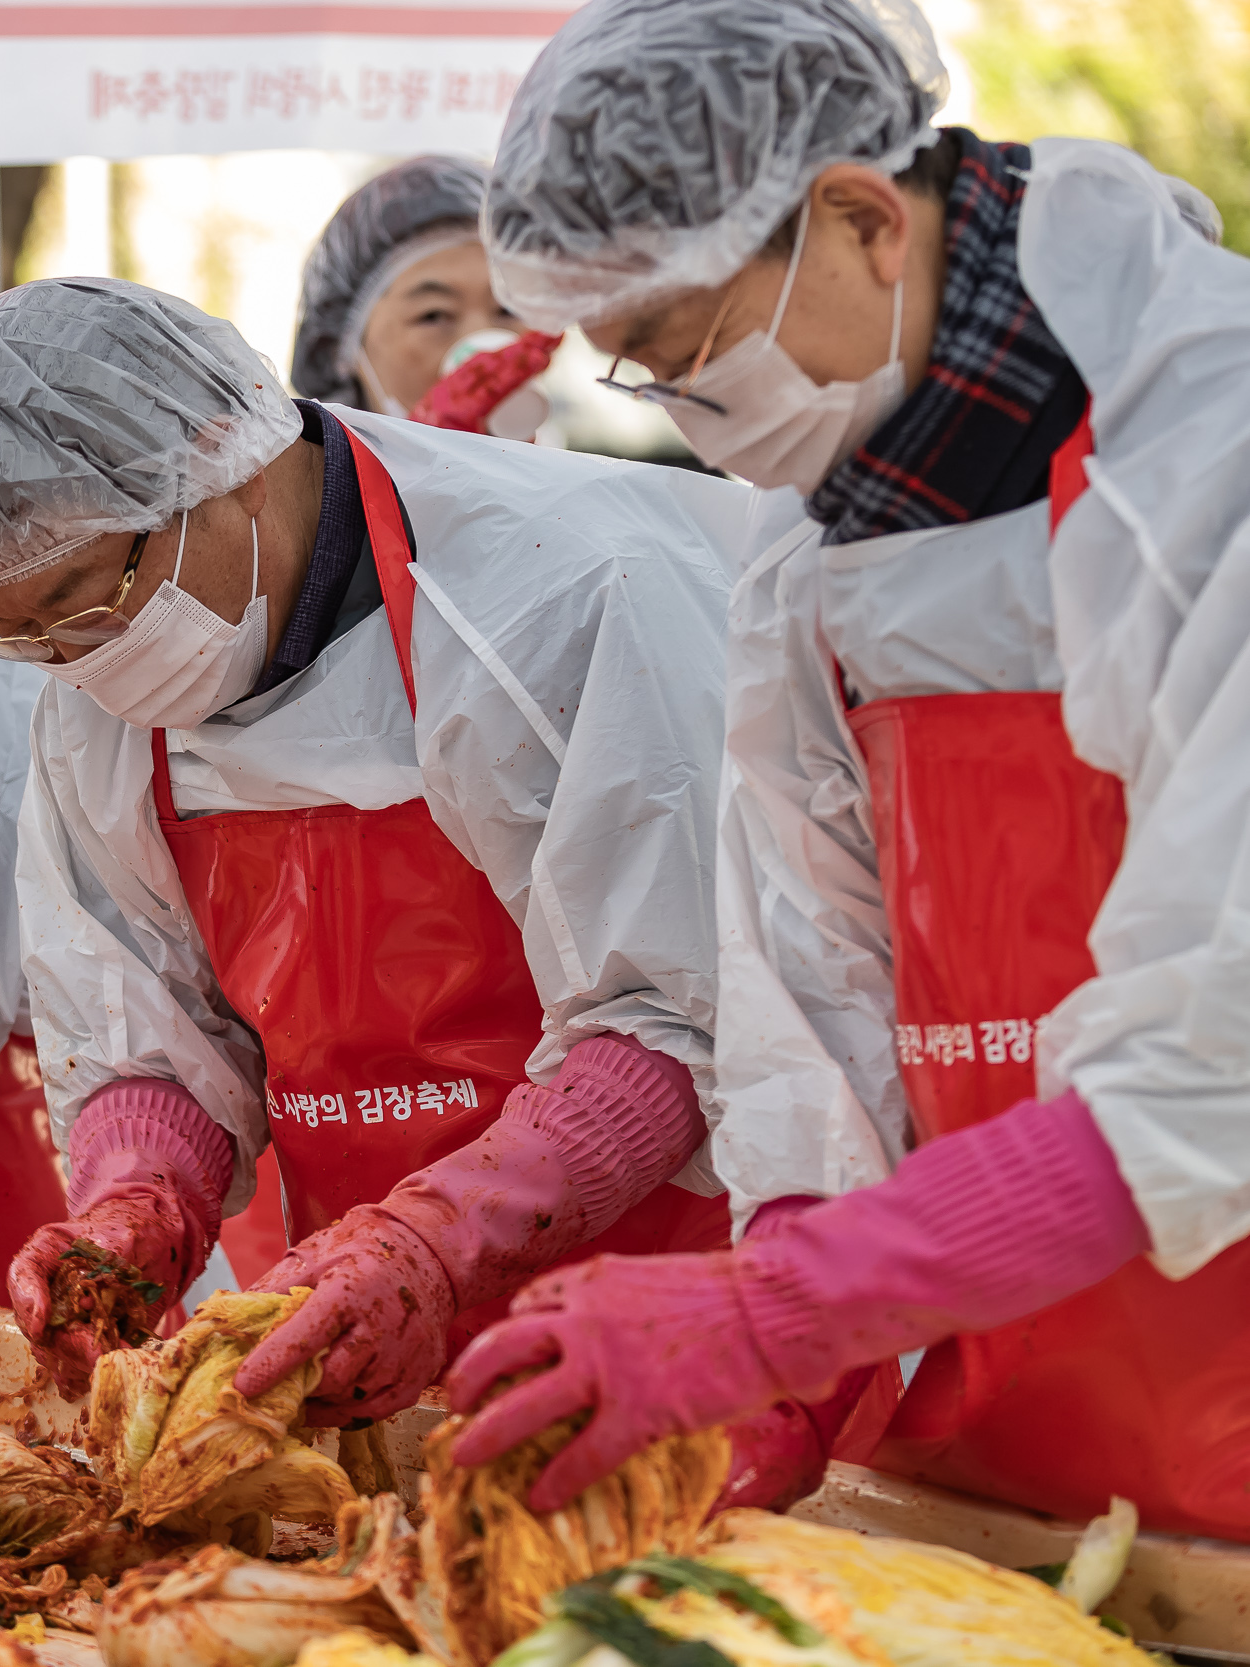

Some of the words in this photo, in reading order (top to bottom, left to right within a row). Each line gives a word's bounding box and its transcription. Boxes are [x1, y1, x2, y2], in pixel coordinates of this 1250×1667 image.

[924, 1023, 975, 1066] 사랑의
[282, 1092, 347, 1128] 사랑의
[354, 1078, 479, 1124] 김장축제
